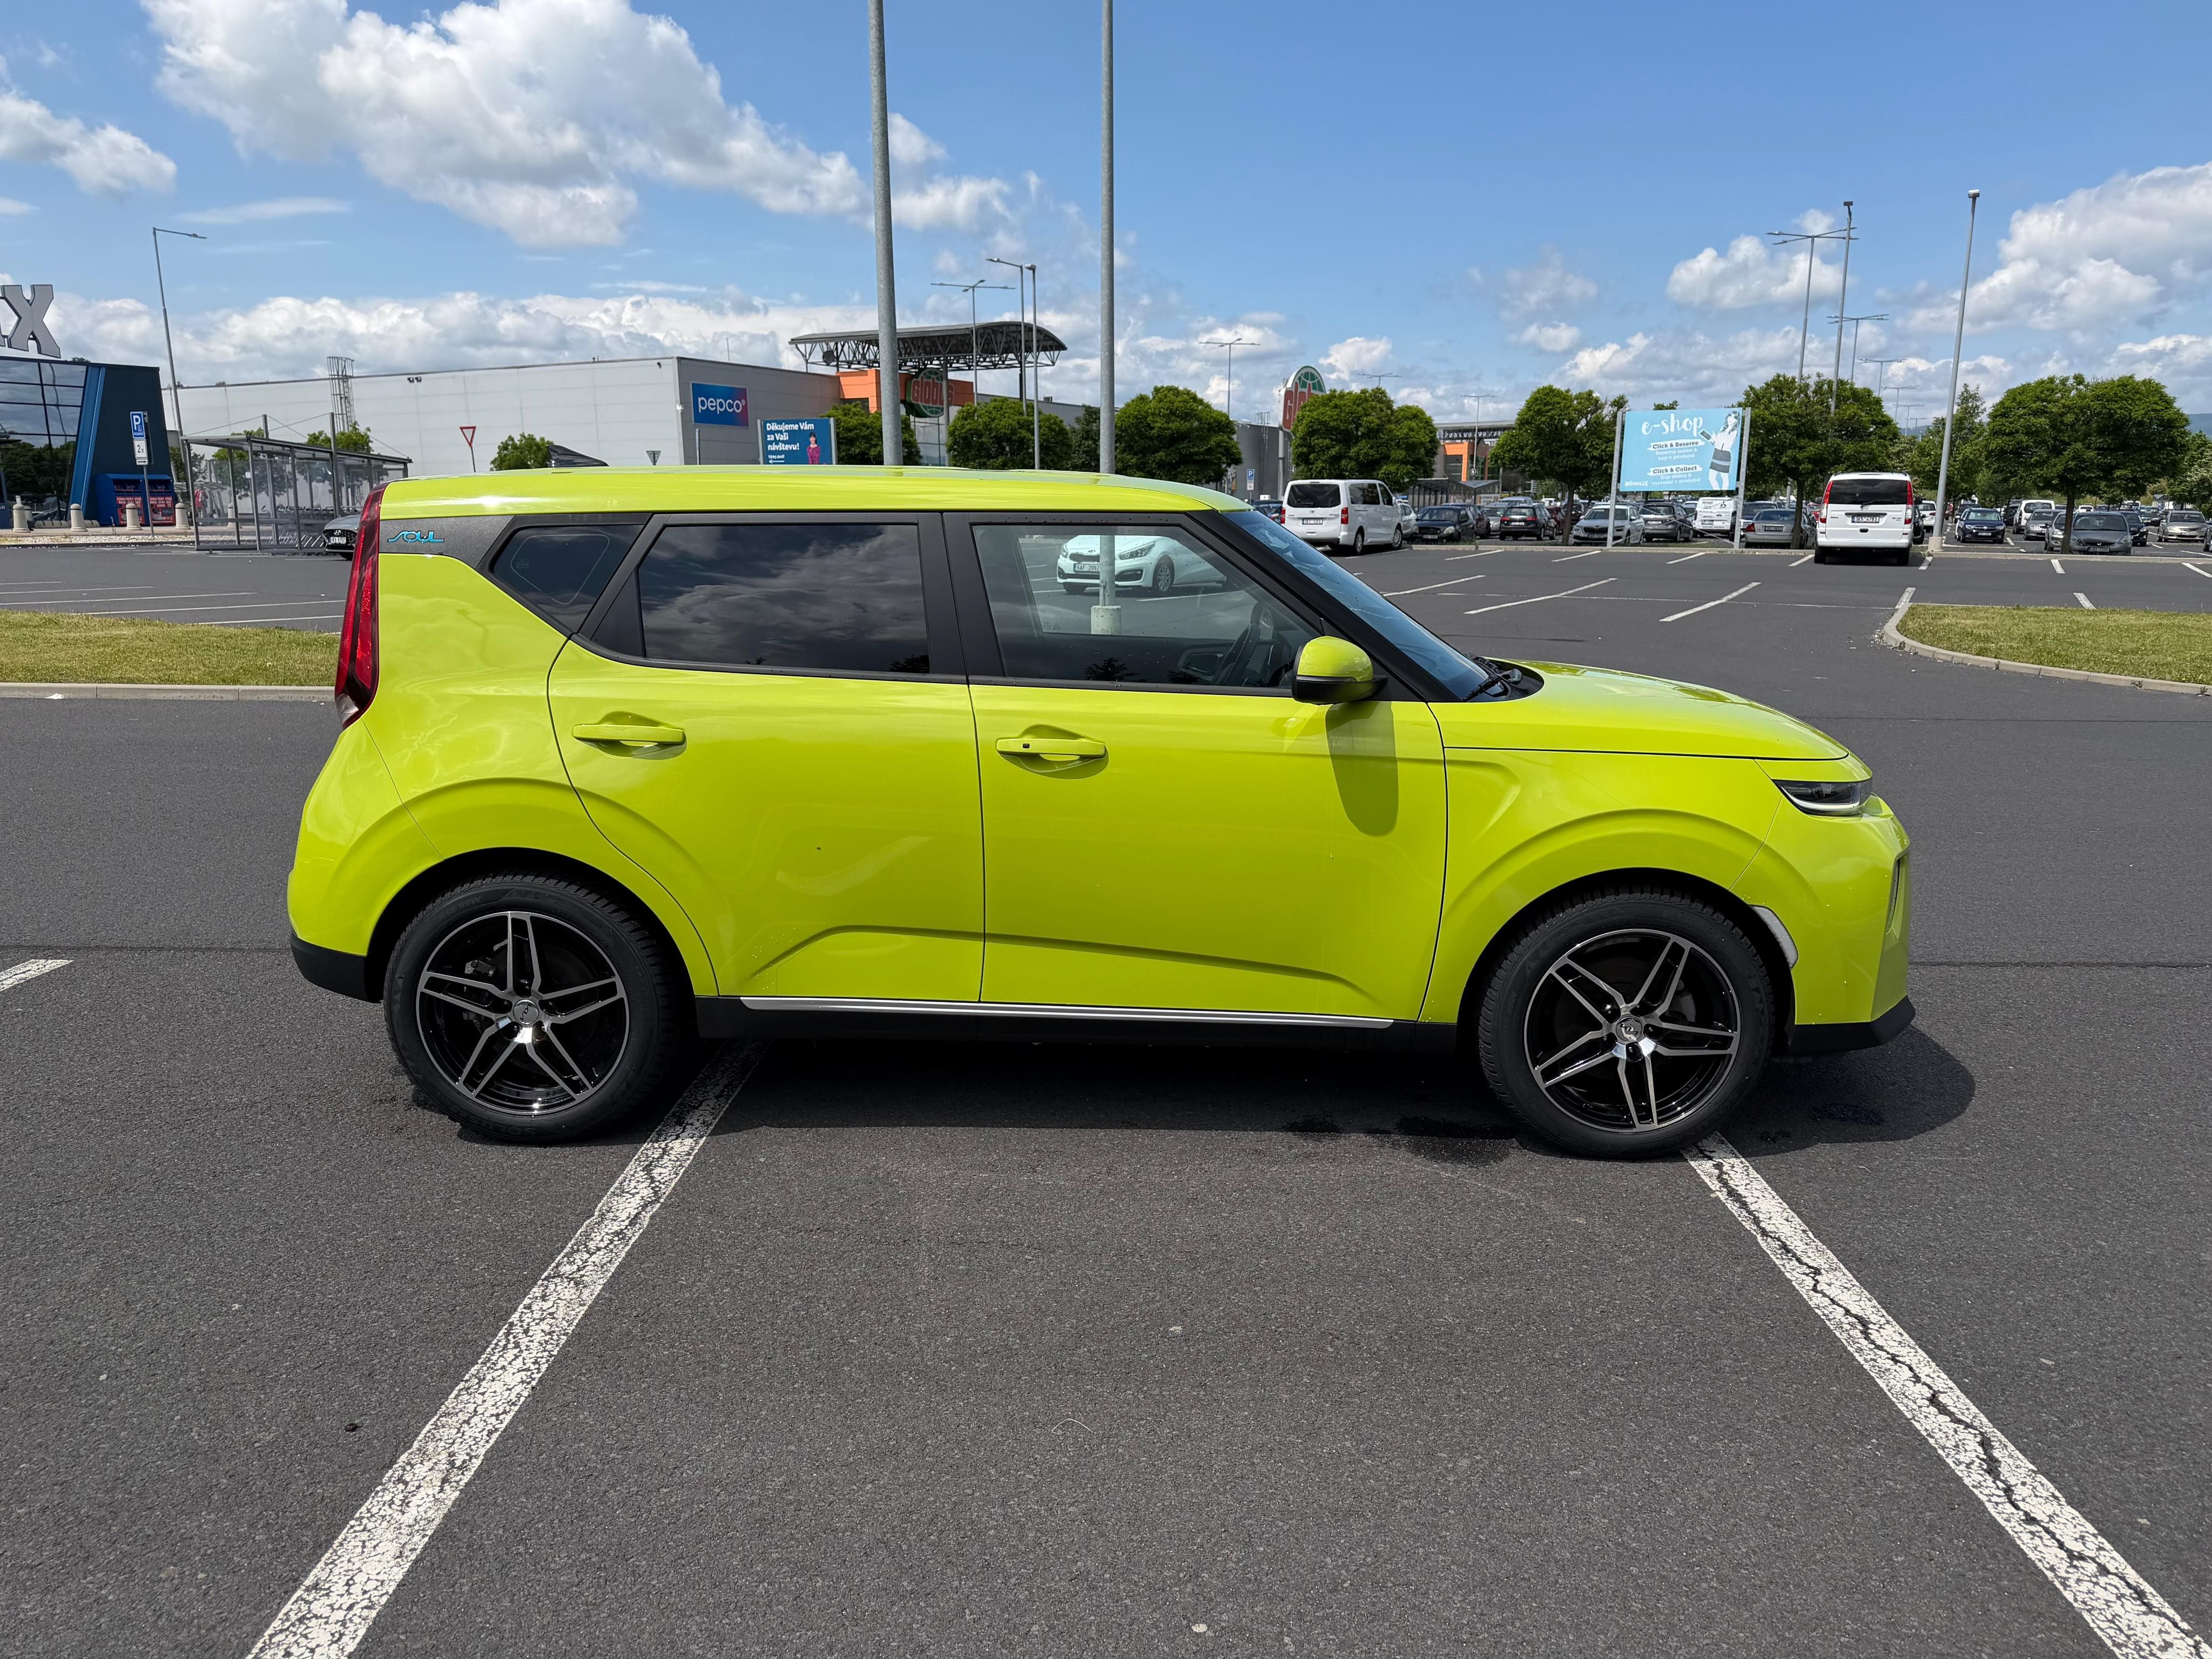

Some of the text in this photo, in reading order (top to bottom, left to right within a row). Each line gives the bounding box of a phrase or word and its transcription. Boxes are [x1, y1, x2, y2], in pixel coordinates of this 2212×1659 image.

[133, 415, 140, 430] P
[766, 421, 814, 431] Děkujeme Vám
[1641, 413, 1703, 437] e-shop
[774, 432, 788, 441] Vaši
